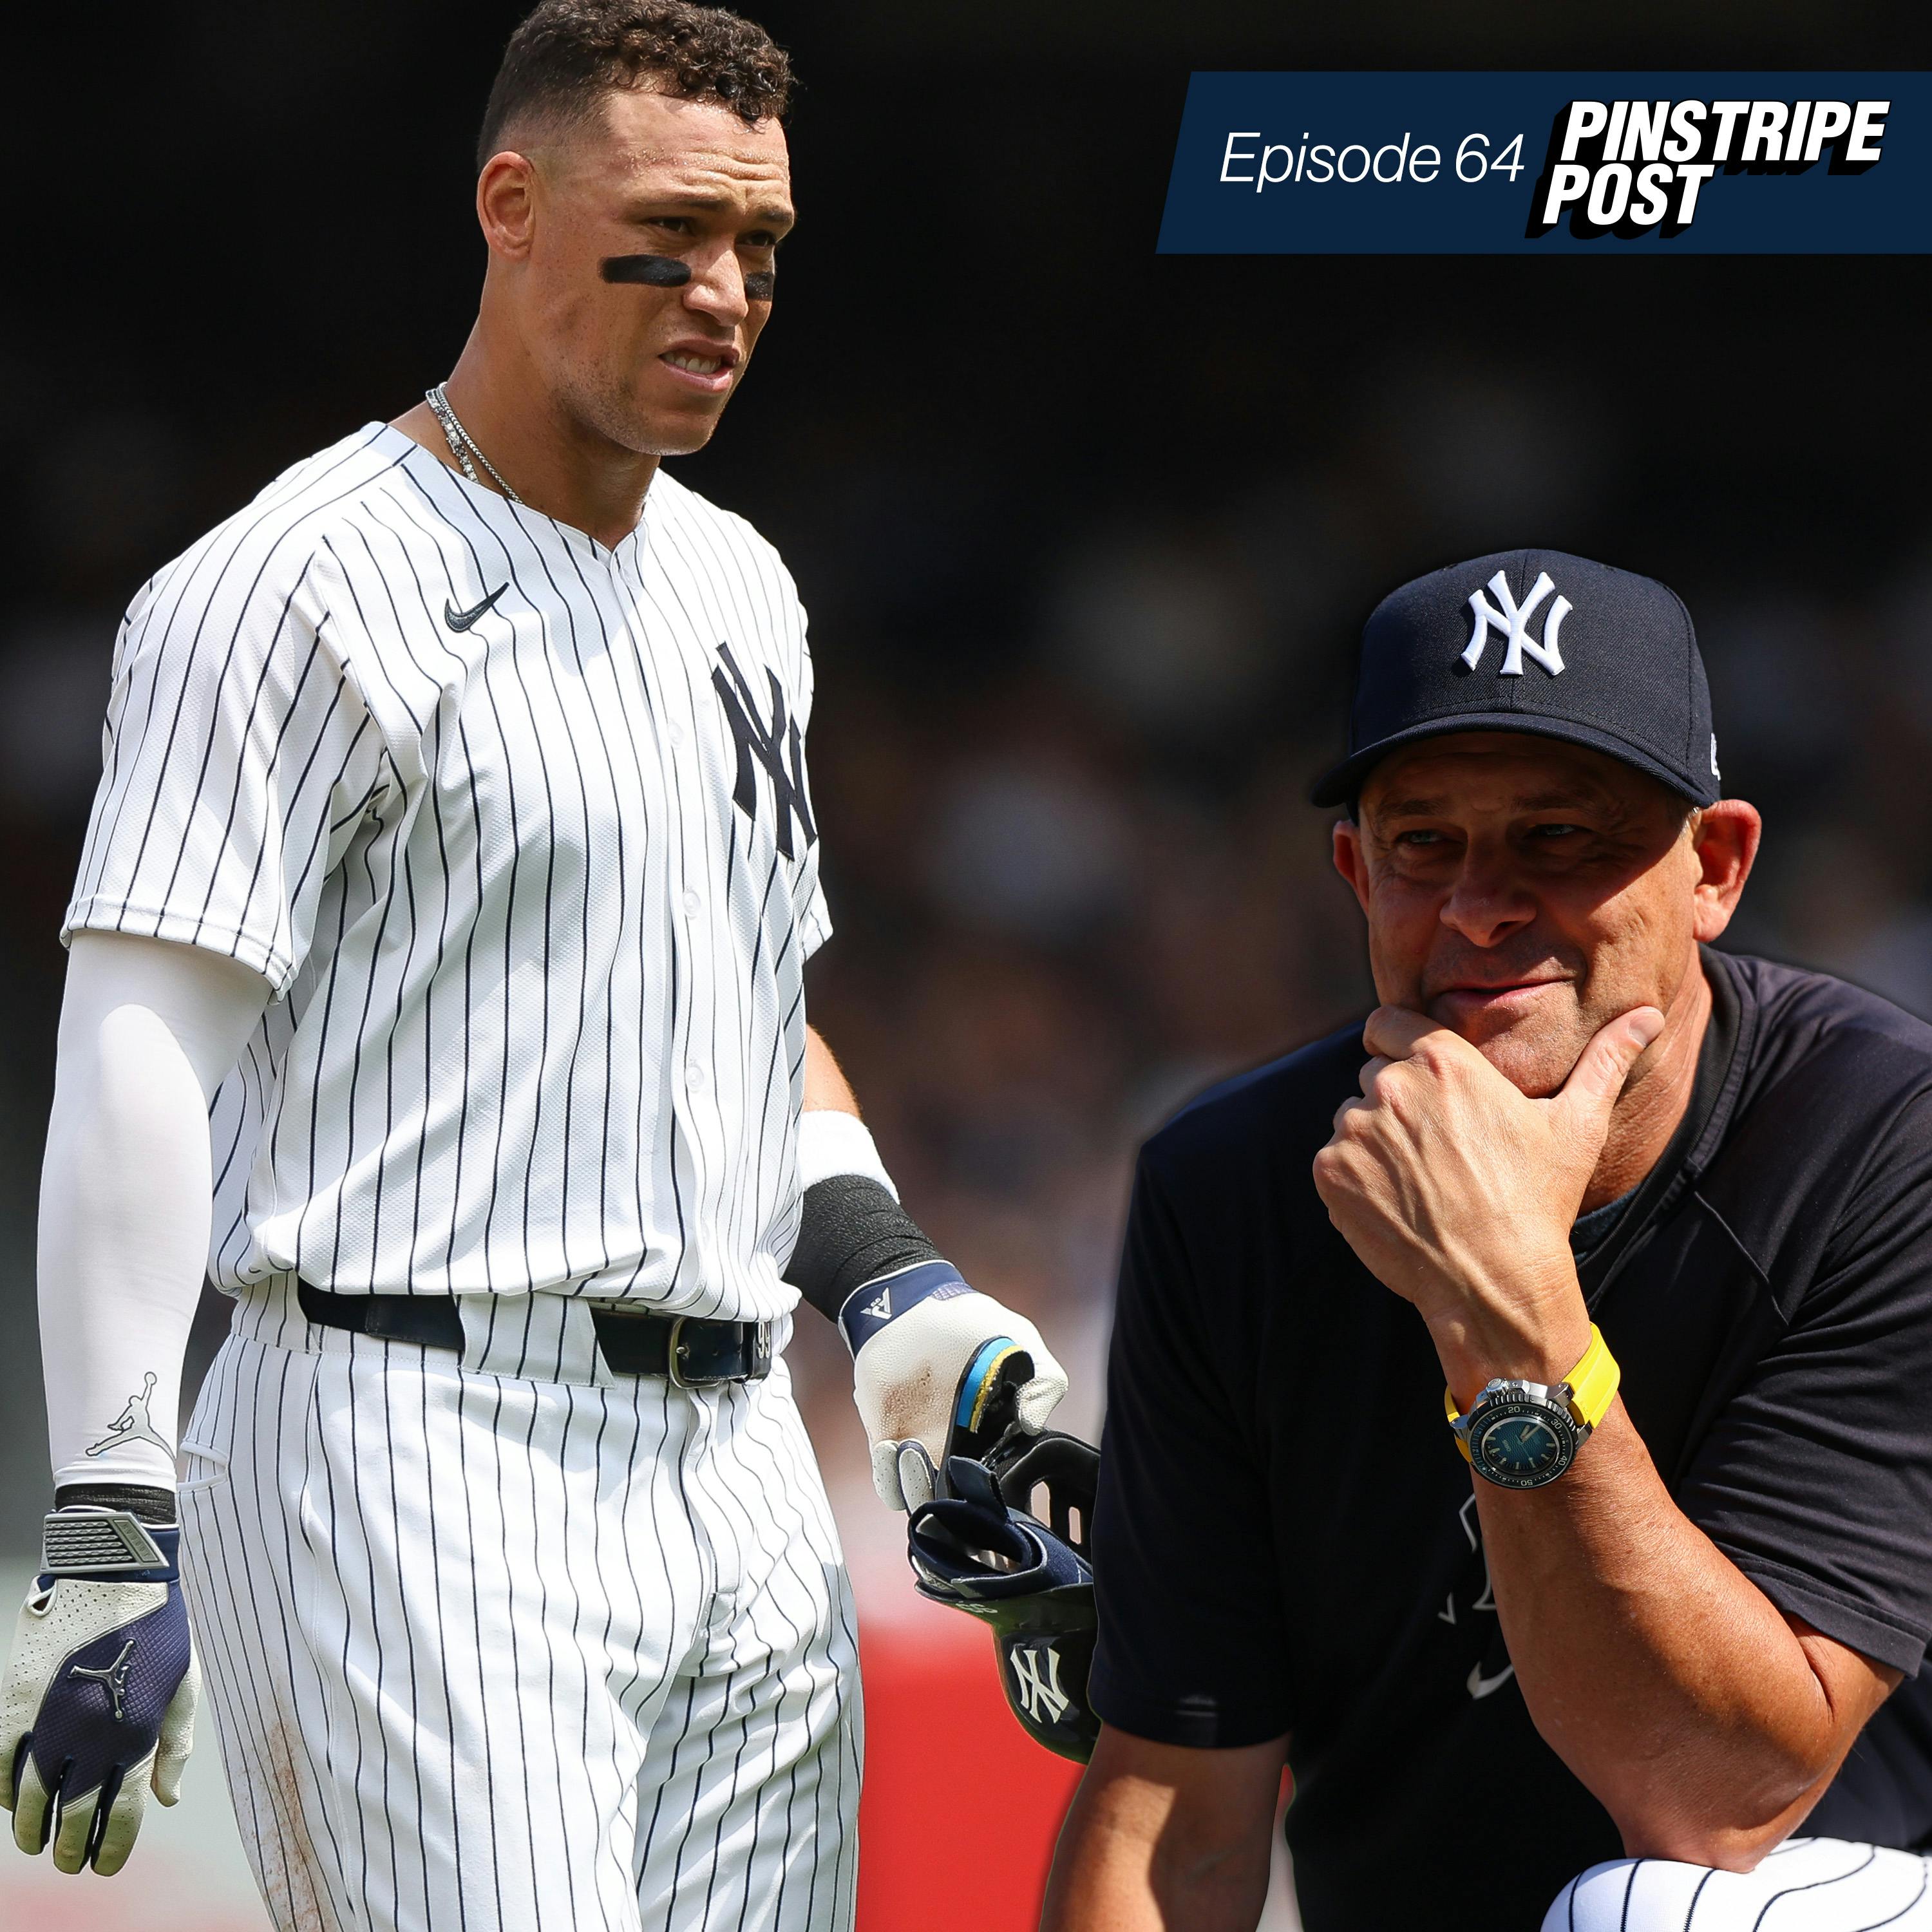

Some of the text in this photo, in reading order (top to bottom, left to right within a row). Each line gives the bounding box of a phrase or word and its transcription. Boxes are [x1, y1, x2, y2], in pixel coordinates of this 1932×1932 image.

[1461, 570, 1573, 676] NY
[710, 640, 818, 862] NY
[757, 1321, 771, 1359] 99
[1551, 1418, 1562, 1430] 30
[1558, 1455, 1567, 1466] 40
[1009, 1647, 1069, 1724] NY
